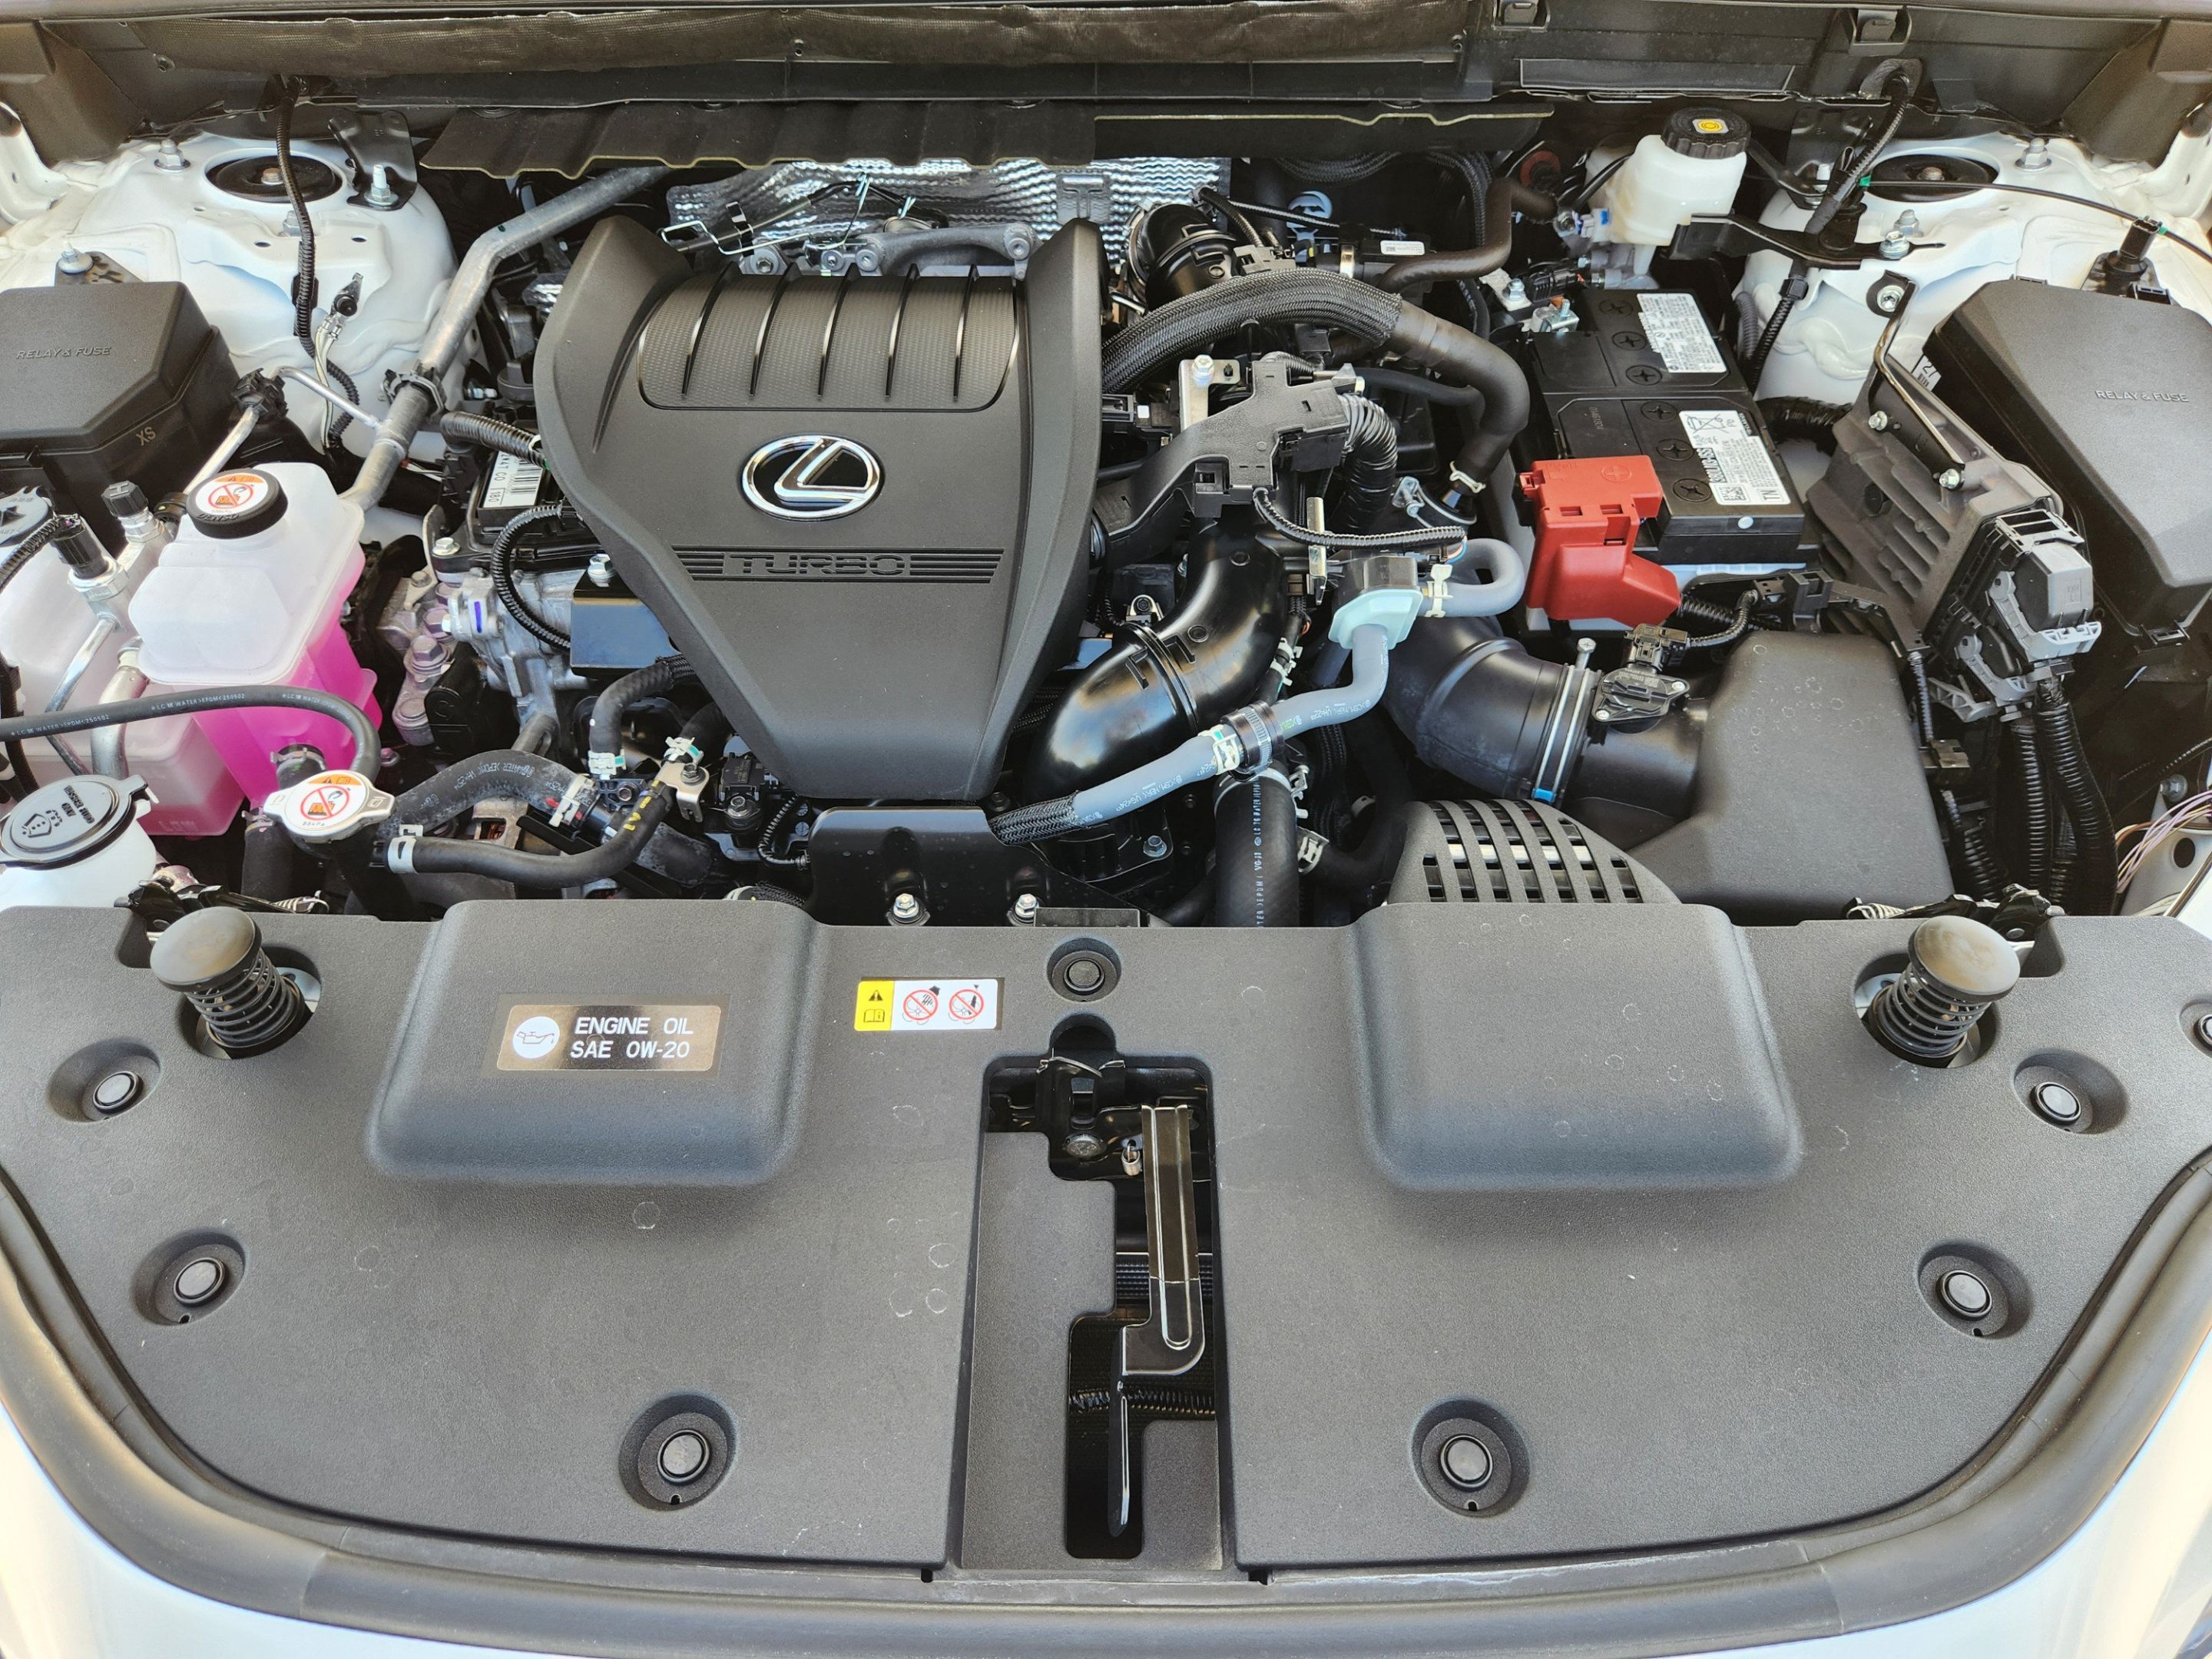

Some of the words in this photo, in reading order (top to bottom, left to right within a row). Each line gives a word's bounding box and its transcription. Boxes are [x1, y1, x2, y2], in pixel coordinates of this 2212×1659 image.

[15, 347, 61, 359] RELAY
[61, 348, 71, 357] &
[75, 346, 112, 356] FUSE
[2094, 390, 2138, 401] RELAY
[2152, 392, 2189, 402] FUSE
[109, 482, 129, 497] H
[1760, 489, 1780, 501] TN
[197, 513, 240, 522] DENSO
[730, 554, 906, 576] TURBO
[175, 698, 198, 707] WATER
[35, 724, 59, 733] WATER
[574, 1016, 651, 1035] ENGINE
[663, 1016, 694, 1035] OIL
[570, 1040, 614, 1058] SAE
[625, 1040, 690, 1058] 0W-20
